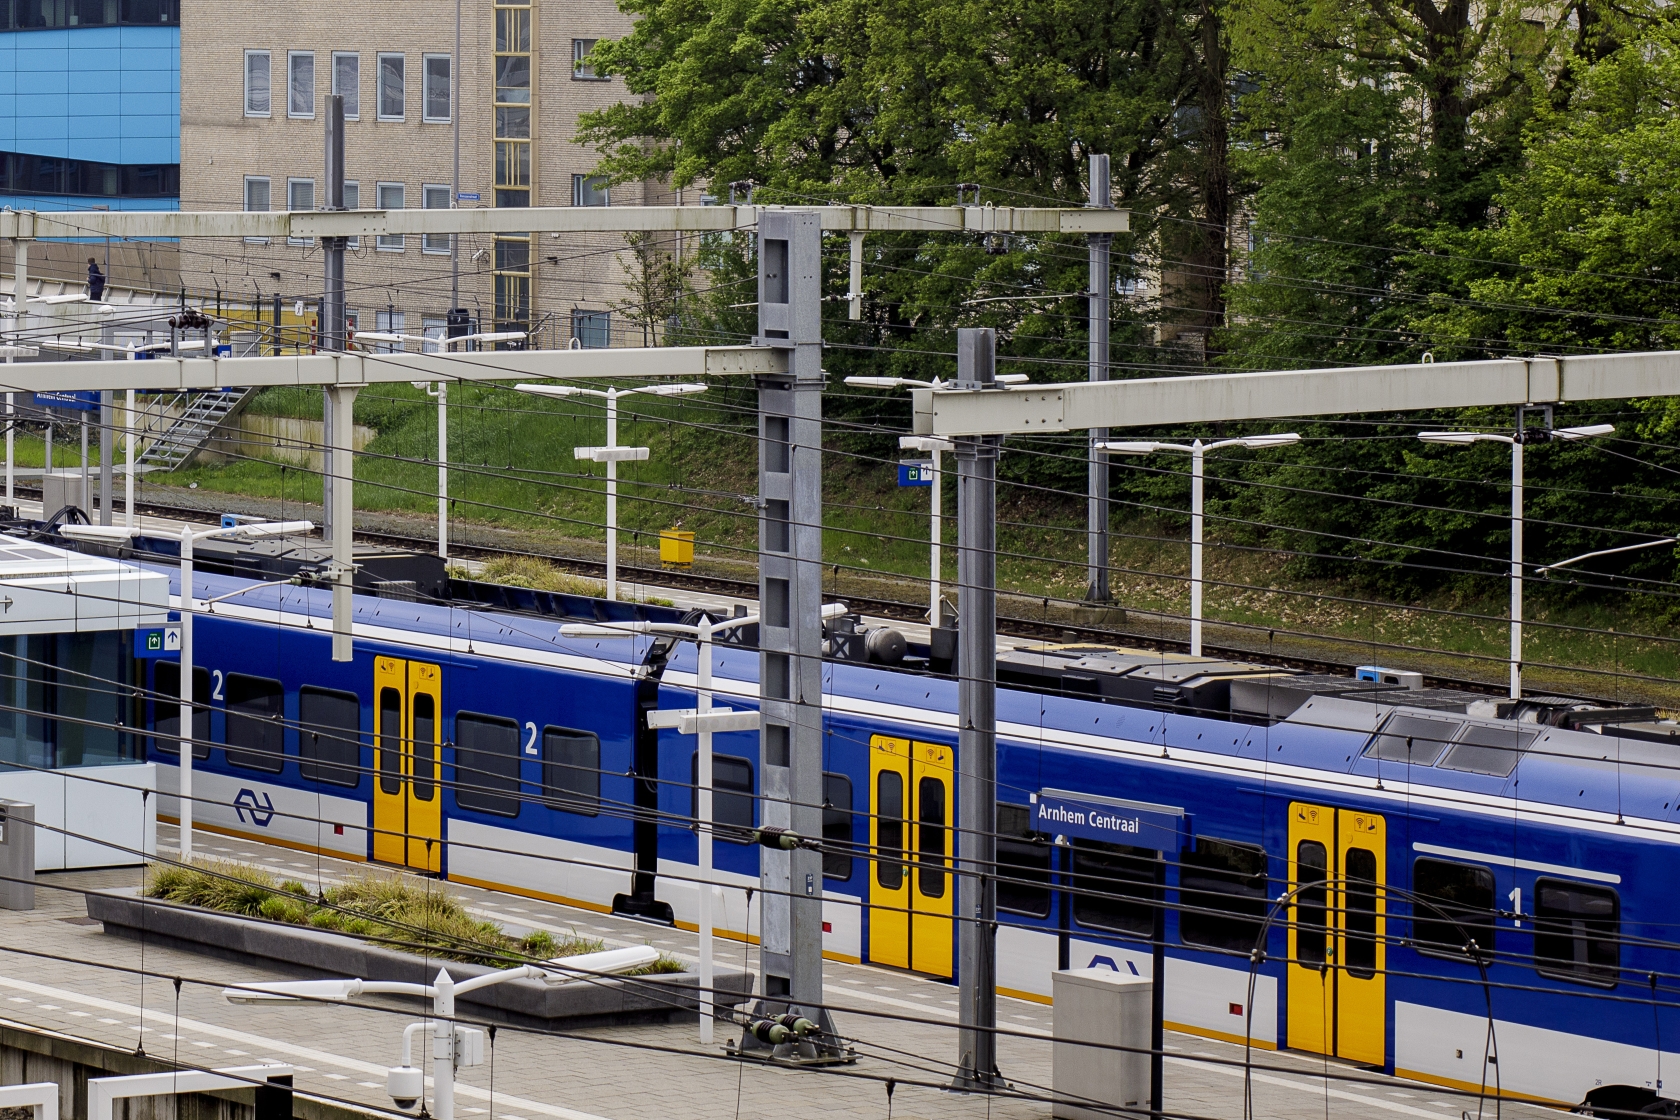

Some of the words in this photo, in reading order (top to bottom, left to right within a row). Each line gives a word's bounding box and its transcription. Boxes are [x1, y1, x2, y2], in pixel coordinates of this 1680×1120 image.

[212, 669, 224, 701] 2
[525, 721, 538, 755] 2
[1038, 803, 1085, 825] Arnhem
[1088, 811, 1140, 834] Centraal
[1508, 887, 1521, 928] 1
